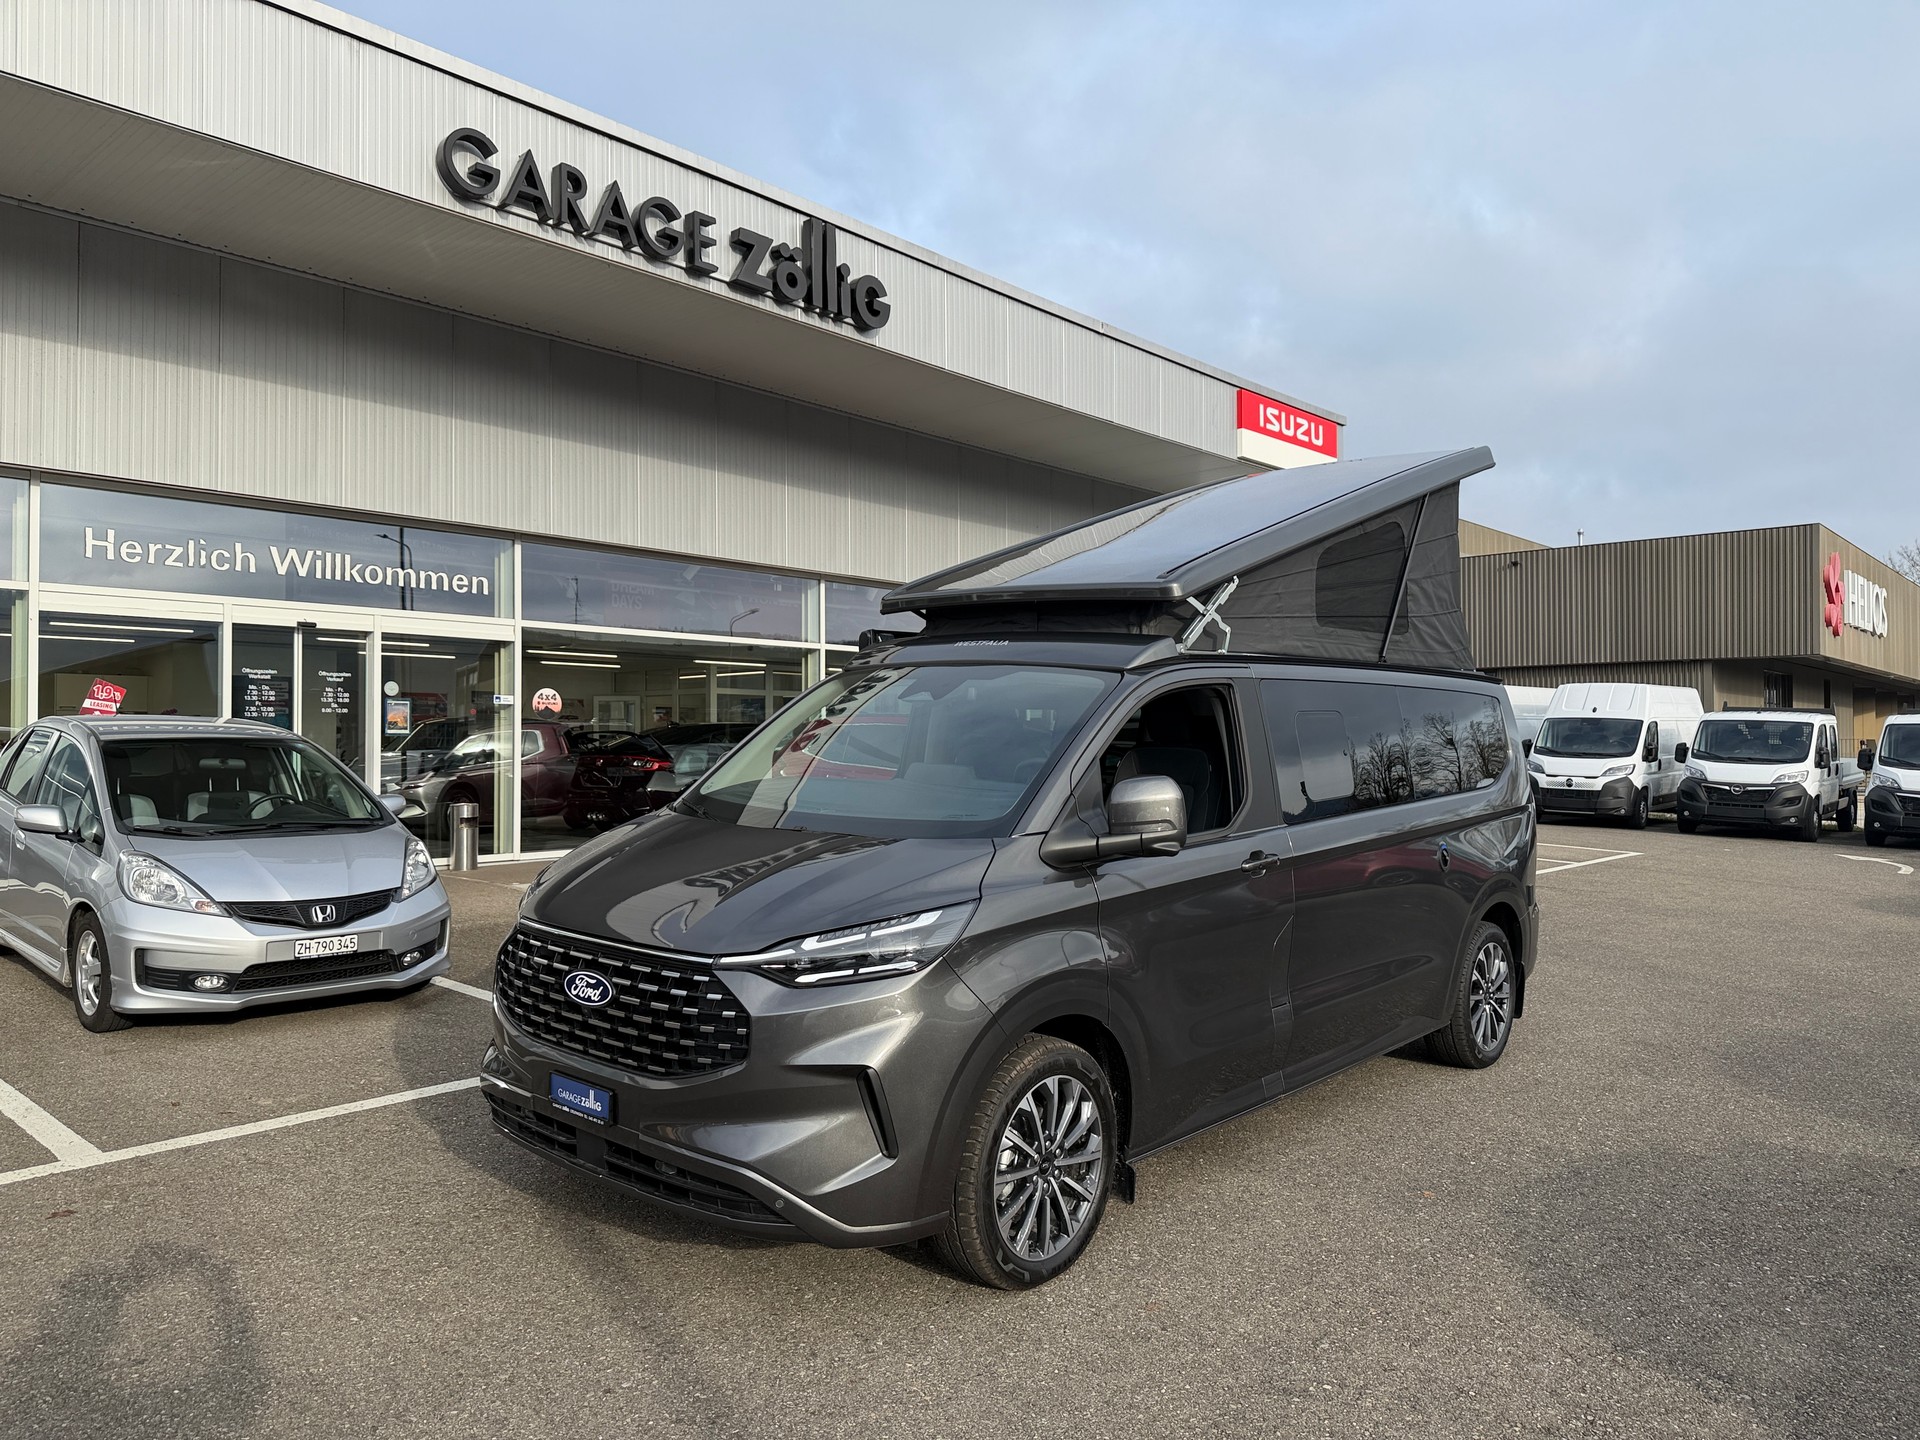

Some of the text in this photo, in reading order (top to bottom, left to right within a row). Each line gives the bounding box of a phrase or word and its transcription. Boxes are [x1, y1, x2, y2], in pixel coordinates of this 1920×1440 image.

[436, 127, 719, 277] GARAGE
[1259, 403, 1323, 447] ISUZU
[84, 526, 489, 596] Herzlich Willkommen
[1843, 569, 1888, 638] HELIOS
[89, 700, 114, 709] LEASING
[537, 692, 557, 701] 4x4
[571, 974, 604, 1002] Ford
